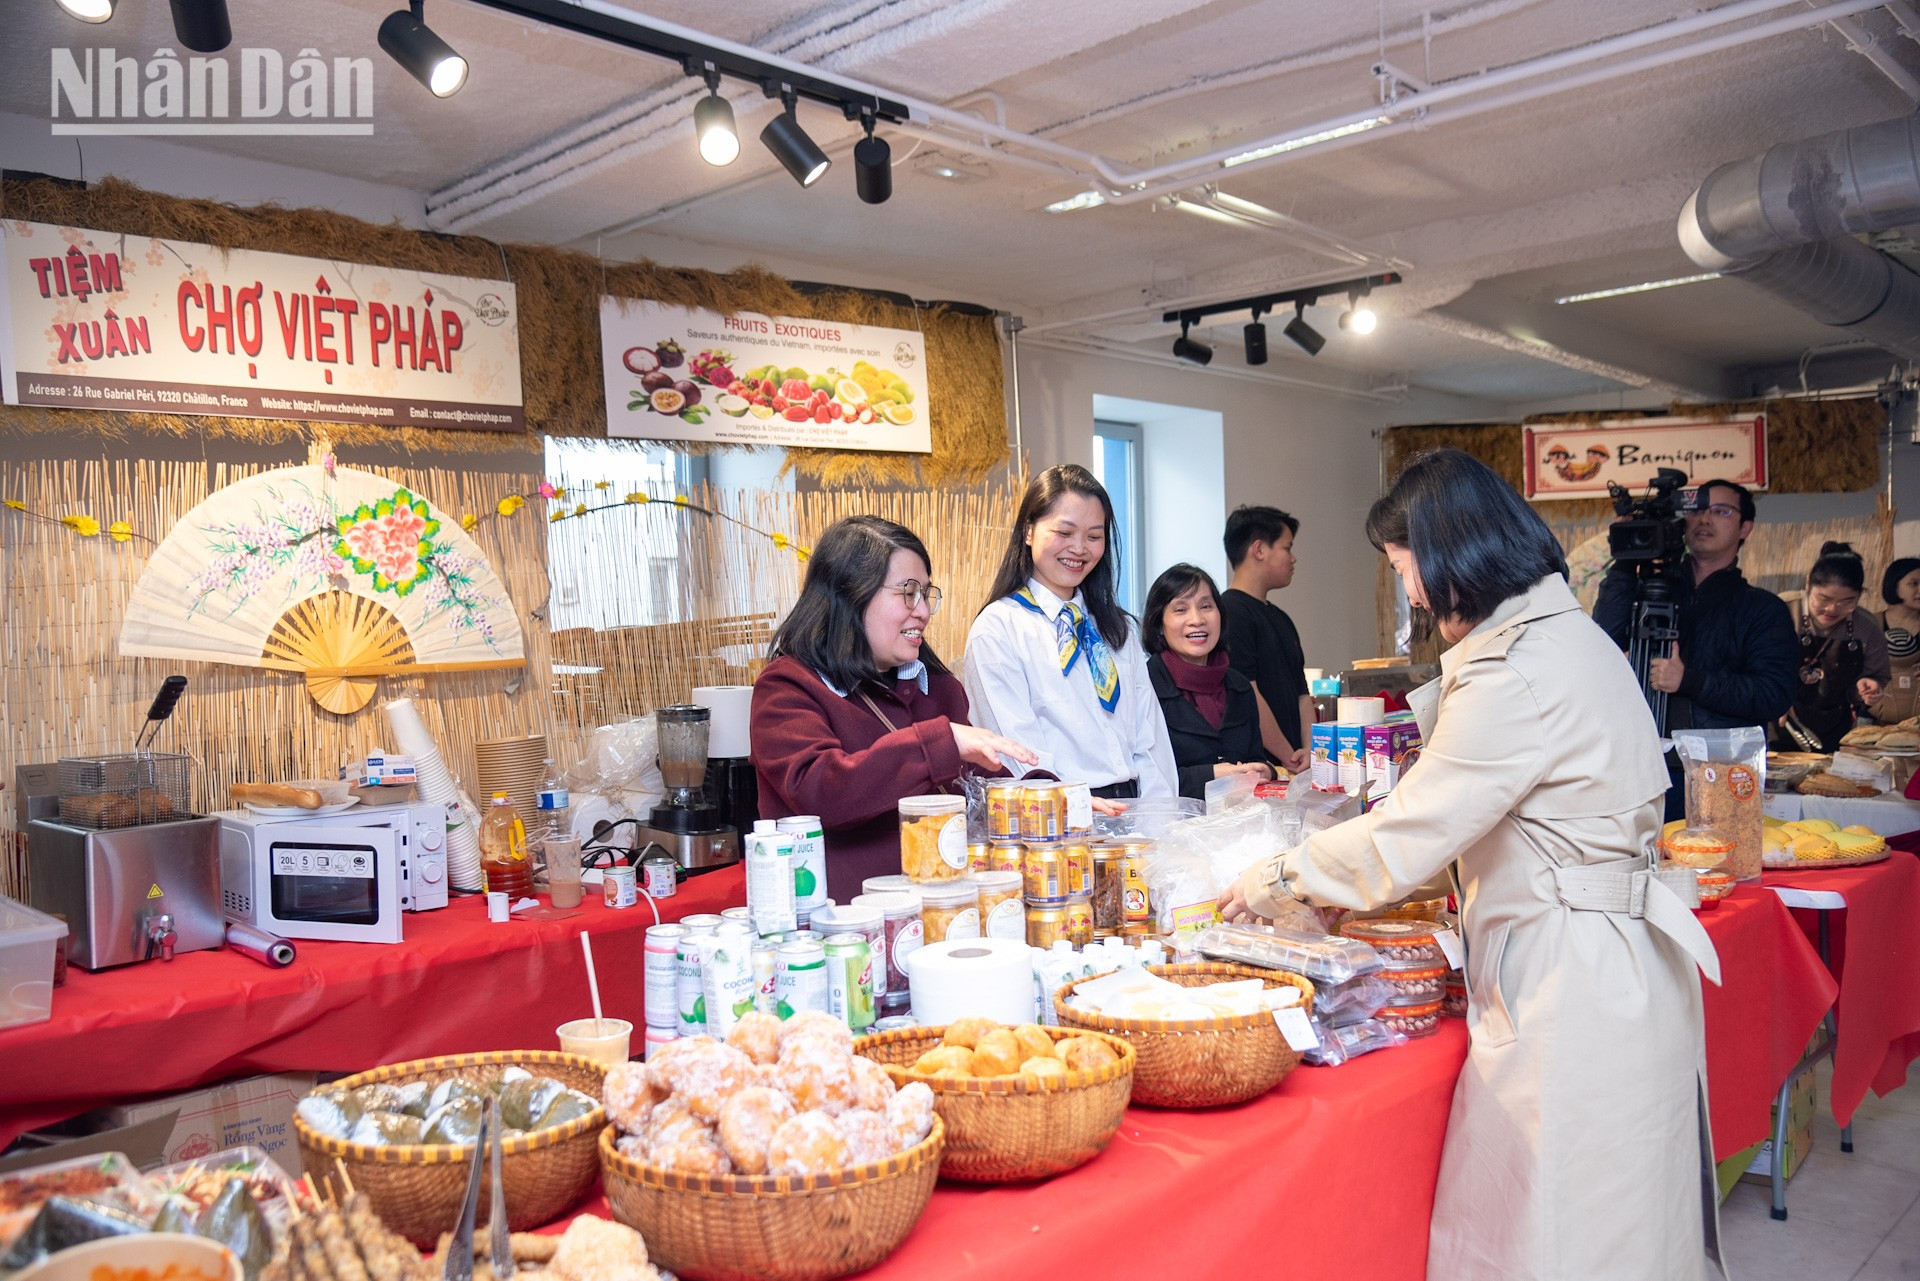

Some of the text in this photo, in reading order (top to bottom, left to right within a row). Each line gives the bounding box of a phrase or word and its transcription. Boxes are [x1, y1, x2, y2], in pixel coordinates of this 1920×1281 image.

[29, 244, 123, 303] TIỆM
[52, 308, 152, 364] XUÂN
[177, 274, 463, 384] CHỢ VIỆT PHÁP
[724, 317, 842, 342] FRUITS EXOTIQUES
[687, 328, 719, 341] Saveurs
[720, 333, 768, 346] authentiques
[770, 337, 780, 346] du
[781, 339, 811, 350] Vietnam,
[814, 343, 848, 354] importées
[28, 383, 66, 396] Adresse
[72, 386, 83, 397] 26
[85, 387, 102, 399] Rue
[104, 388, 135, 401] Gabriel
[136, 389, 156, 402] Péri,
[157, 391, 182, 403] 92320
[183, 392, 220, 407] Châtillon,
[221, 397, 248, 408] France
[260, 397, 293, 410] Website:
[409, 407, 429, 418] Email
[433, 410, 513, 424] contact@chovietphap.com
[797, 843, 814, 853] JUICE
[280, 856, 295, 864] 20L
[302, 856, 308, 865] 5
[780, 976, 796, 987] JUICE
[257, 1122, 287, 1136] Vàng
